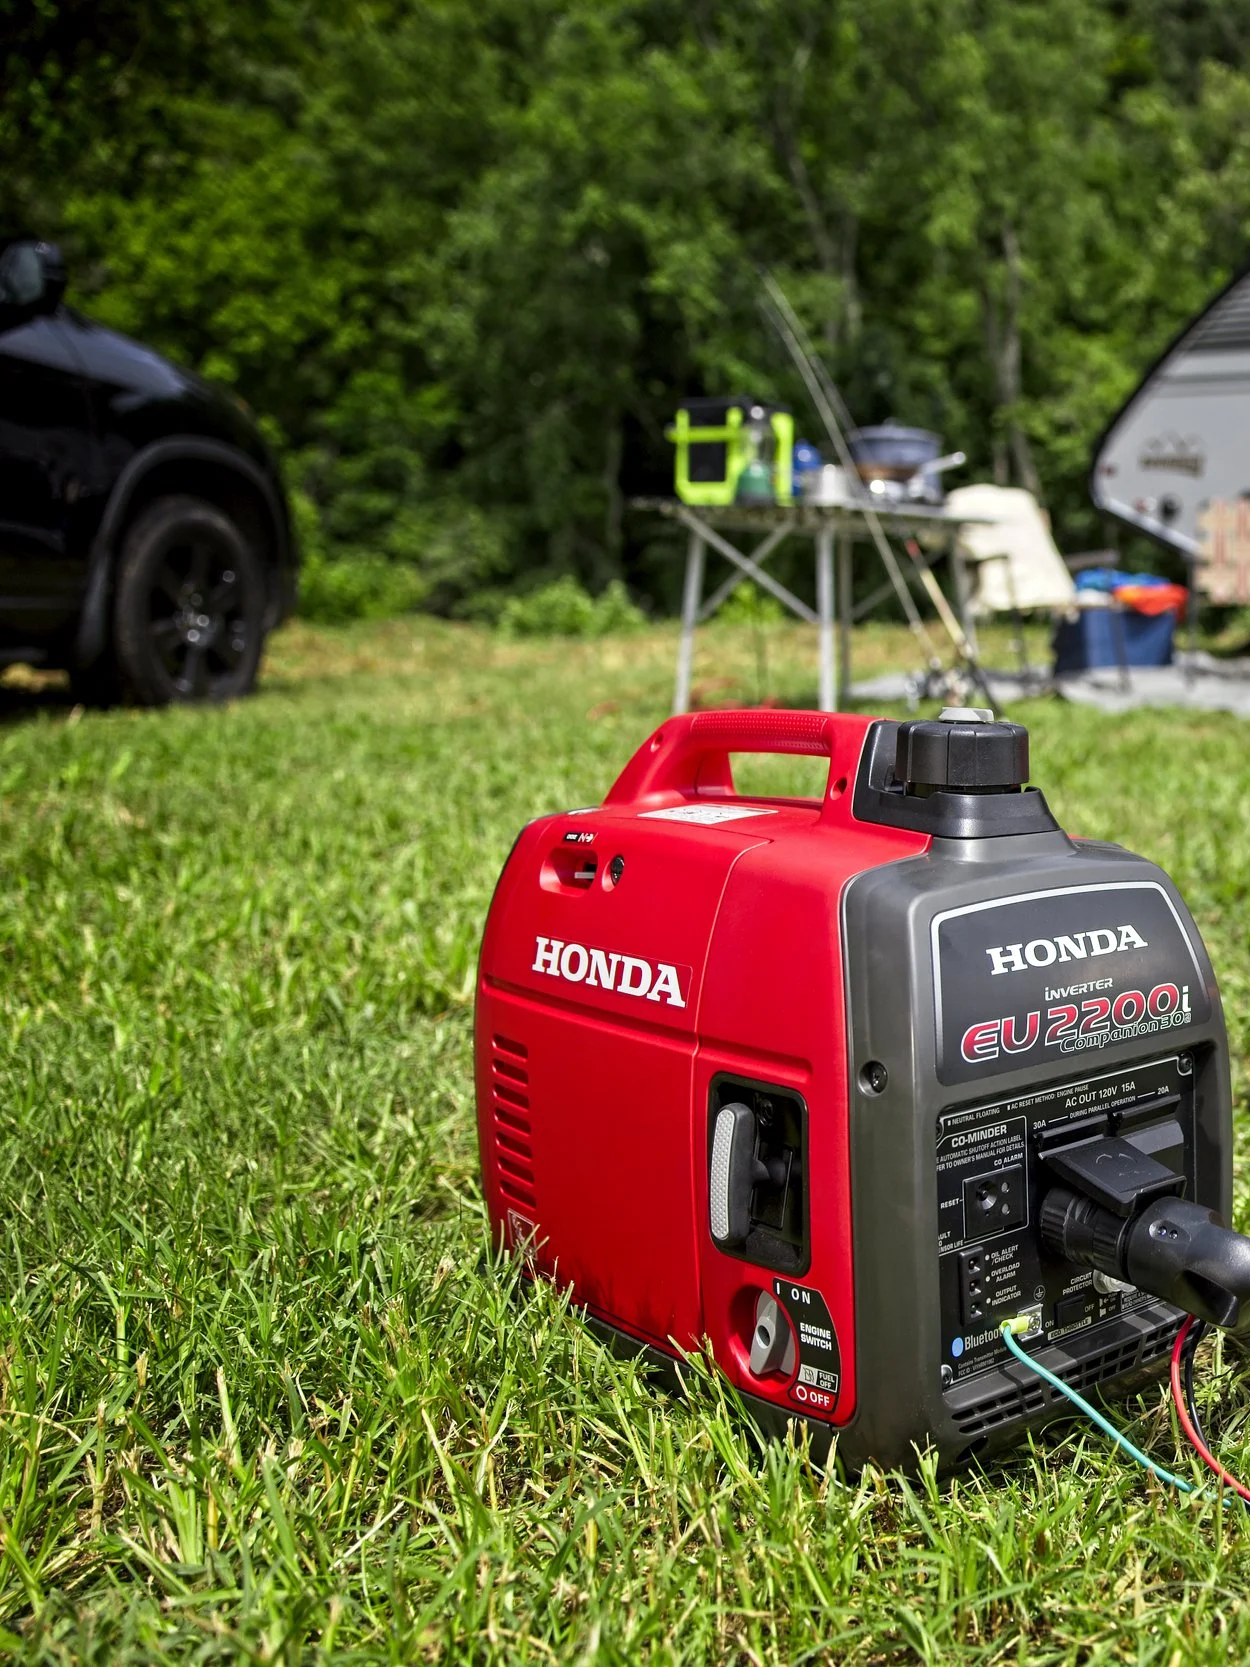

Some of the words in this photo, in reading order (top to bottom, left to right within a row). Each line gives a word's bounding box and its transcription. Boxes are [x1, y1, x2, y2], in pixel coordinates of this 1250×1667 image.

[986, 924, 1148, 975] HONDA
[532, 936, 686, 1008] HONDA
[1060, 1019, 1158, 1053] Companion
[1018, 1098, 1034, 1107] RESET
[1056, 1088, 1073, 1098] ENGINE
[1074, 1084, 1089, 1093] PAUSE
[1065, 1097, 1077, 1108] AC
[1078, 1091, 1097, 1104] OUT
[1099, 1086, 1118, 1100] 120V
[1122, 1081, 1136, 1093] 15A
[1157, 1086, 1169, 1095] 20A
[1070, 1109, 1088, 1119] DURING
[1088, 1102, 1110, 1115] PARALLEL
[1111, 1096, 1136, 1108] OPERATION
[952, 1113, 975, 1125] NEUTRAL
[976, 1108, 1000, 1119] FLOATING
[1033, 1120, 1046, 1130] 30A
[952, 1125, 1007, 1148] CO-MINDER
[940, 1150, 968, 1162] AUTOMATIC
[969, 1144, 990, 1154] SHUTOFF
[990, 1139, 1007, 1148] ACTION
[1008, 1134, 1022, 1143] LABEL
[954, 1156, 975, 1166] OWNER'S
[976, 1151, 996, 1160] MANUAL
[1006, 1142, 1024, 1152] DETAILS
[994, 1158, 1002, 1166] CO
[1004, 1153, 1024, 1164] ALARM
[940, 1198, 960, 1209] RESET
[954, 1240, 963, 1248] LIFE
[1001, 1244, 1019, 1254] ALERT
[991, 1262, 1020, 1277] OVERLOAD
[996, 1271, 1016, 1283] ALARM
[1070, 1272, 1092, 1285] CIRCUIT
[995, 1285, 1017, 1297] OUTPUT
[1062, 1280, 1093, 1295] PROTECTOR
[791, 1288, 810, 1304] ON
[991, 1291, 1021, 1306] INDICATOR
[1085, 1304, 1095, 1312] OFF
[800, 1322, 831, 1339] ENGINE
[1045, 1320, 1054, 1328] ON
[800, 1334, 832, 1351] SWITCH
[819, 1372, 835, 1383] FUEL
[820, 1379, 832, 1389] OFF
[810, 1392, 830, 1406] OFF
